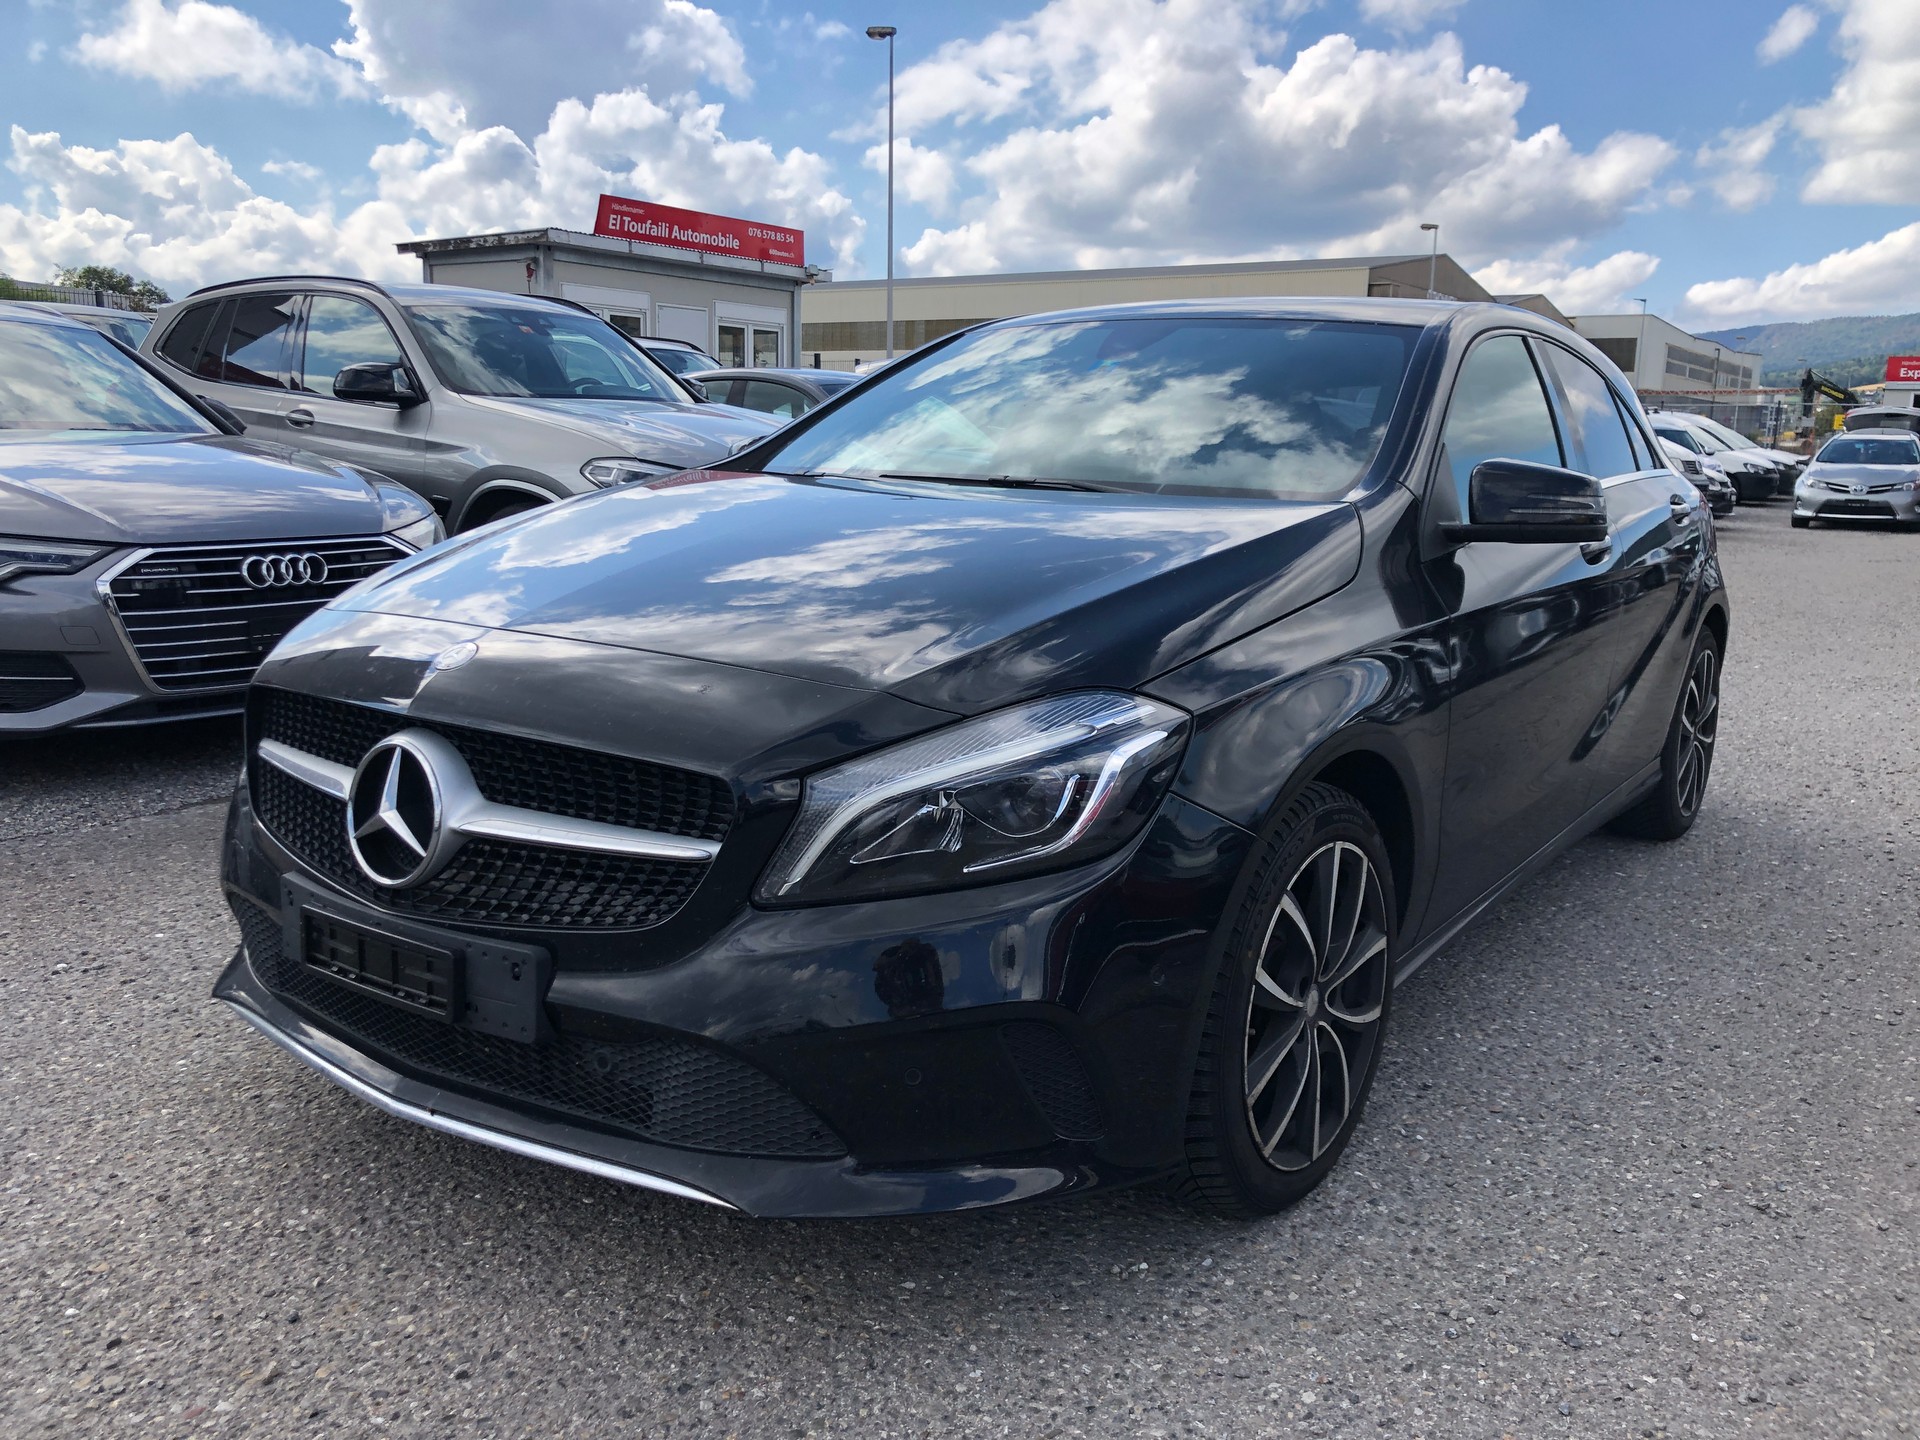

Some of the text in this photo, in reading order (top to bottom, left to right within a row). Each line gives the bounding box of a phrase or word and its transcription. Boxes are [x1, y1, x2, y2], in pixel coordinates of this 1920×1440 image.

[608, 214, 740, 250] El Toufaili Automobile
[748, 227, 795, 244] 076 578 85 54
